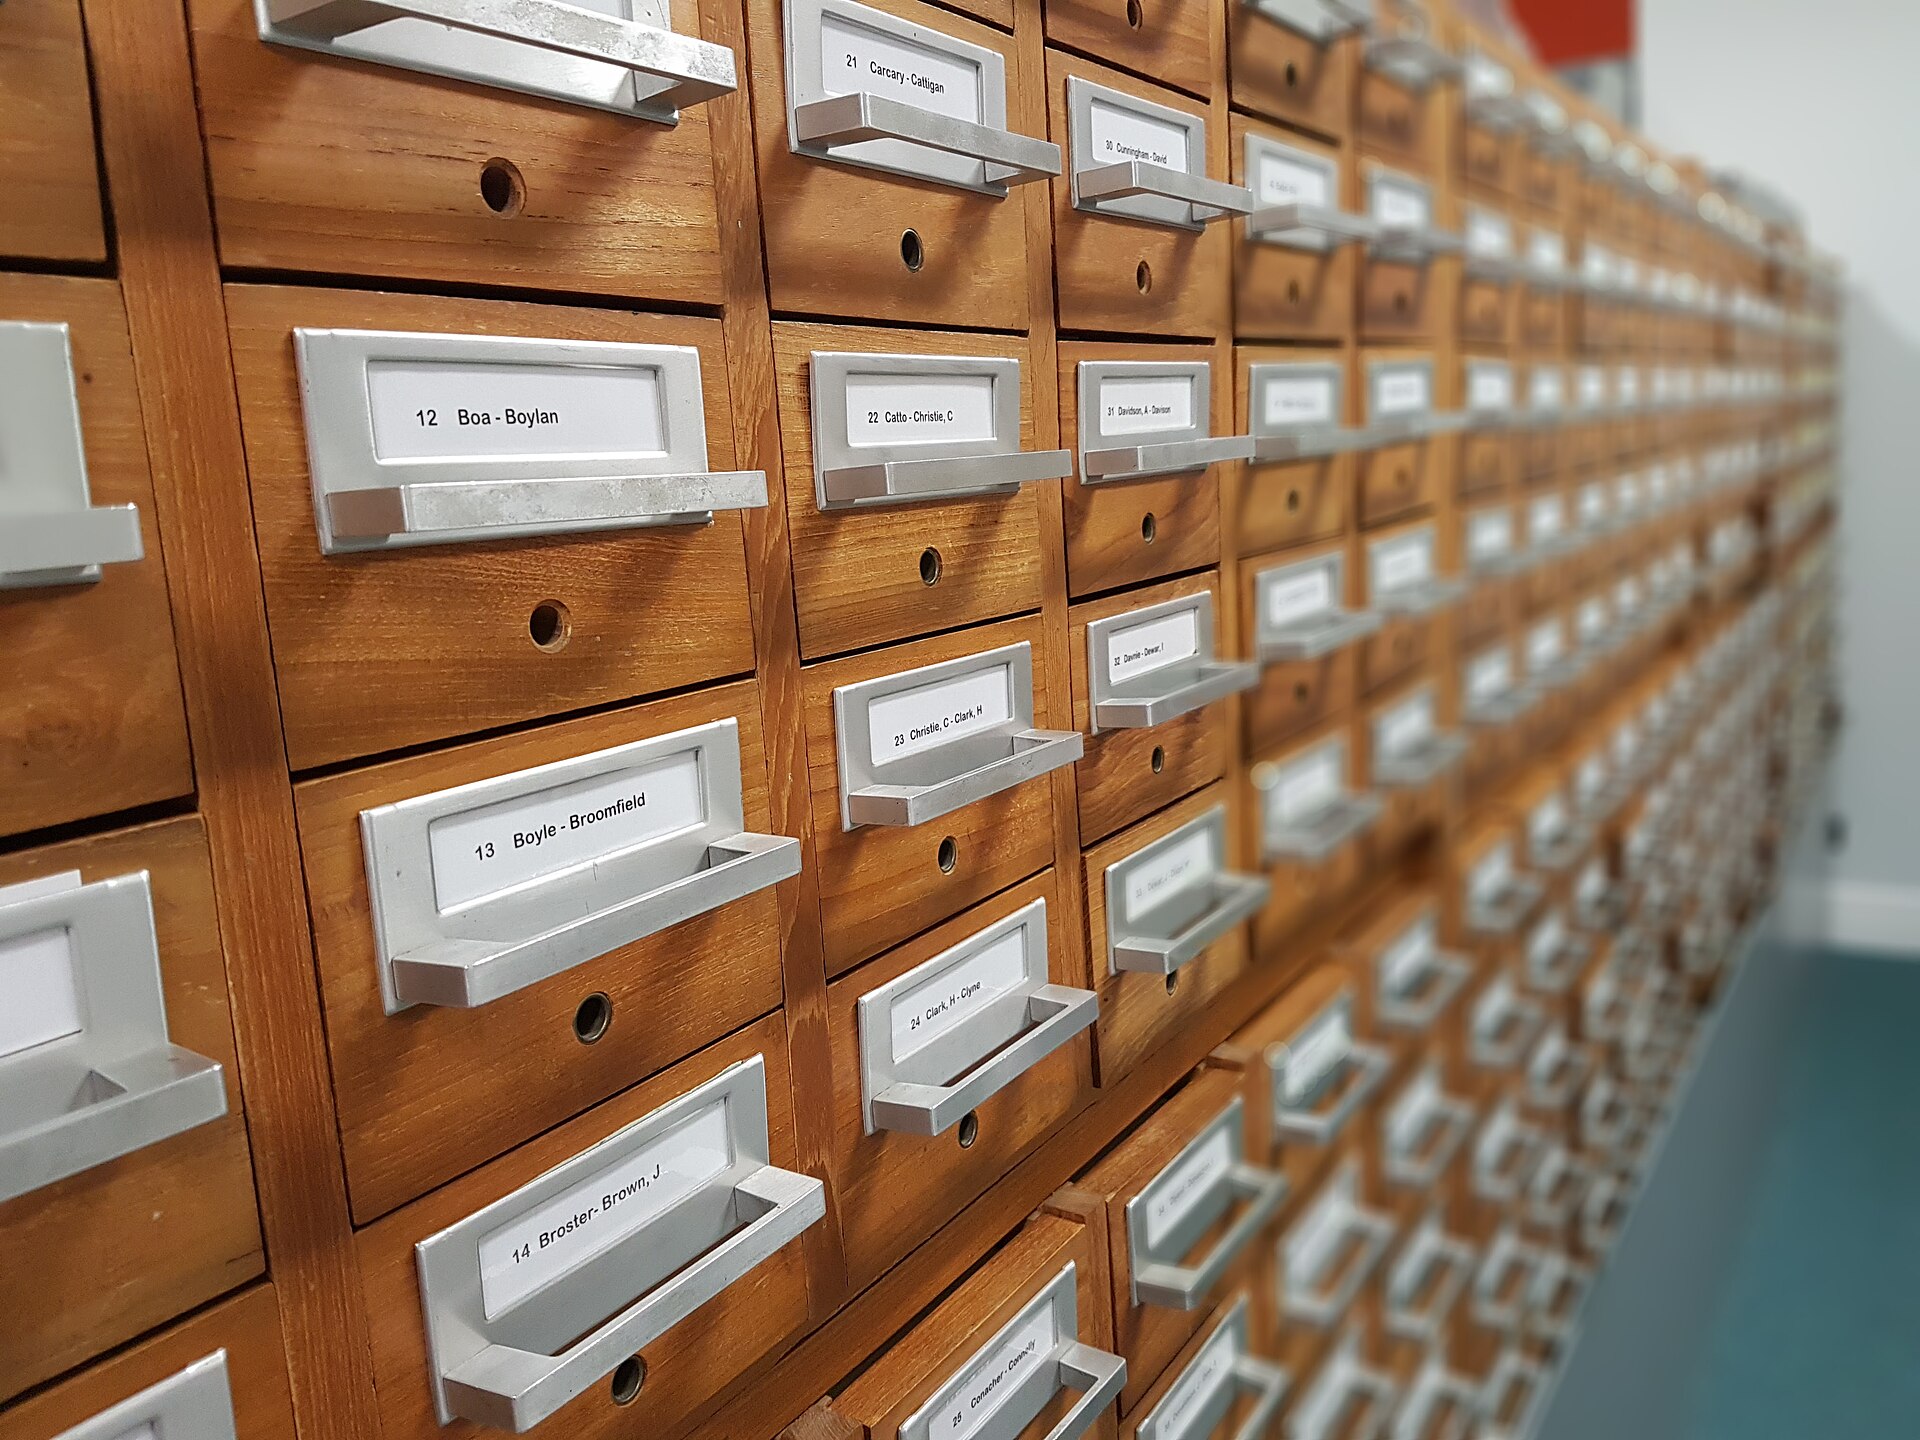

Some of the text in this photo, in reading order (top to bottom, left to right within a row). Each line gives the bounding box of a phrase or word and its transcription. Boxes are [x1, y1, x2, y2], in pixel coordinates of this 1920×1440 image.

[846, 54, 857, 68] 21
[870, 61, 905, 85] Carcary
[911, 73, 945, 94] Cattigan
[1105, 139, 1114, 151] 30
[1116, 142, 1150, 160] Cunningham
[1152, 152, 1168, 164] David
[416, 409, 438, 426] 12
[457, 408, 491, 425] Boa
[505, 408, 559, 428] Boylan
[868, 411, 879, 423] 22
[885, 411, 907, 423] Catto
[913, 410, 946, 424] Christie,
[947, 410, 953, 421] C
[1107, 406, 1115, 416] 31
[1118, 406, 1144, 416] Davidson,
[1144, 405, 1149, 414] A
[894, 733, 905, 747] 23
[910, 722, 942, 740] Christie,
[943, 717, 949, 728] C
[954, 709, 976, 724] Clark,
[977, 704, 983, 716] H
[475, 842, 495, 861] 13
[513, 824, 557, 849] Boyle
[569, 792, 646, 830] Broomfield
[910, 1015, 921, 1030] 24
[925, 1001, 948, 1020] Clark,
[949, 994, 956, 1006] H
[960, 981, 981, 998] Clyne
[512, 1243, 531, 1264] 14
[602, 1176, 650, 1211] Brown,
[653, 1163, 661, 1179] J
[952, 1411, 962, 1428] 25
[970, 1370, 1004, 1409] Conacher
[1008, 1339, 1036, 1371] Connolly
